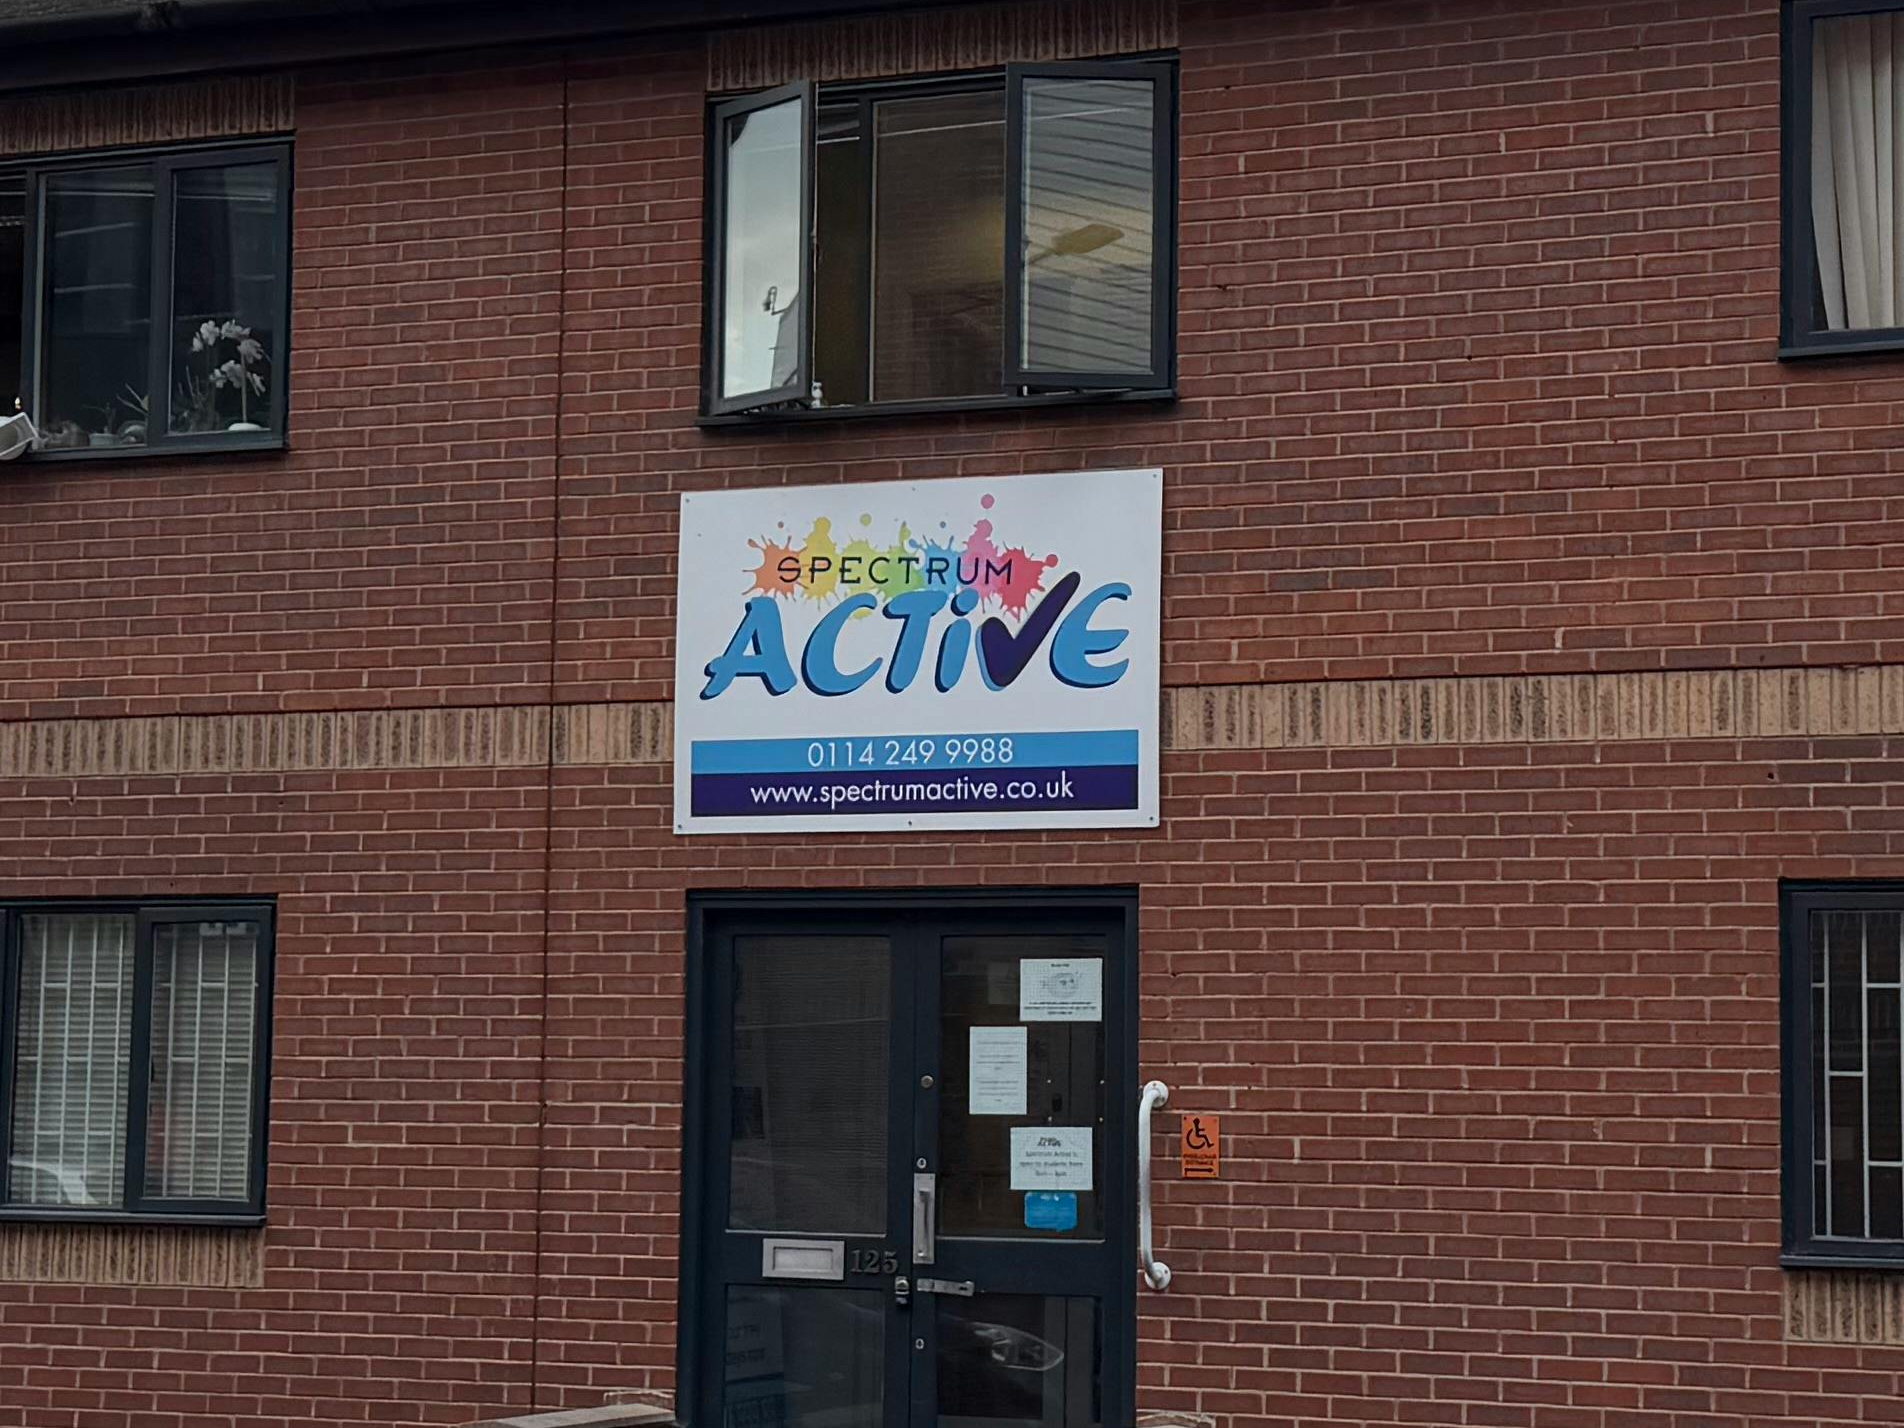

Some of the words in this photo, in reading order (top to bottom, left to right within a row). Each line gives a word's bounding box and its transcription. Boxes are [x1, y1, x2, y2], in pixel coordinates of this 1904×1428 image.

[776, 556, 1013, 585] SPECTRUM
[807, 739, 874, 767] 0114
[885, 738, 935, 766] 249
[945, 737, 1013, 764] 9988
[750, 770, 1074, 810] www.spectrumactive.co.uk
[850, 1249, 898, 1274] 125
